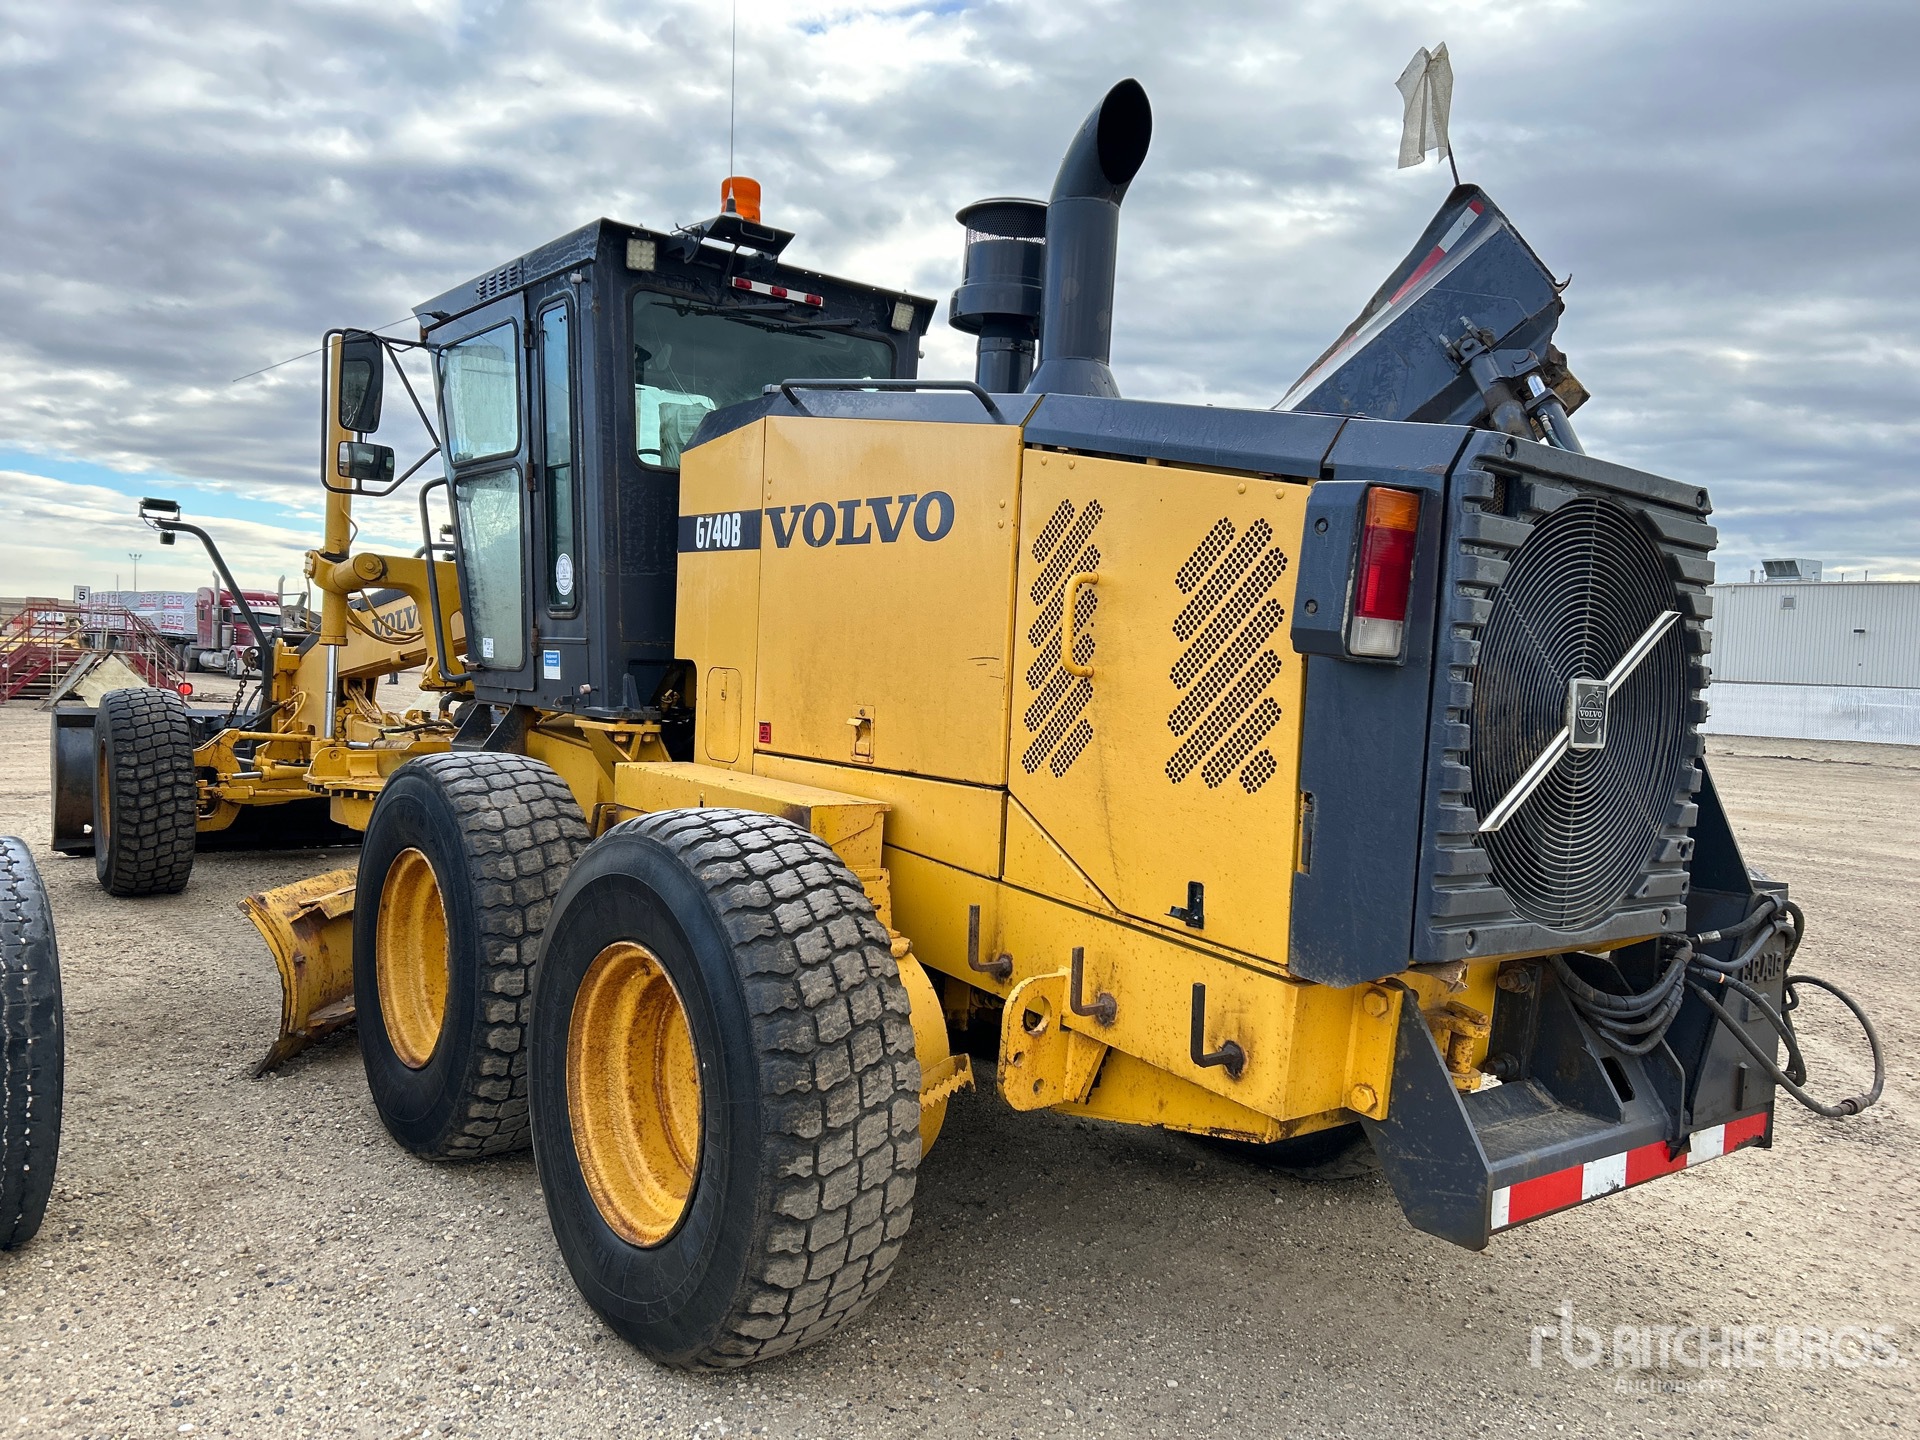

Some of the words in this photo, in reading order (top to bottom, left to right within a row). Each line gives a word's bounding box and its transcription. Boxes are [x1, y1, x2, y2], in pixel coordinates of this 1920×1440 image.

[695, 512, 741, 548] G740B
[765, 490, 955, 548] VOLVO
[78, 591, 86, 601] 5
[371, 604, 422, 636] VOLV
[1580, 710, 1602, 718] VOLVO
